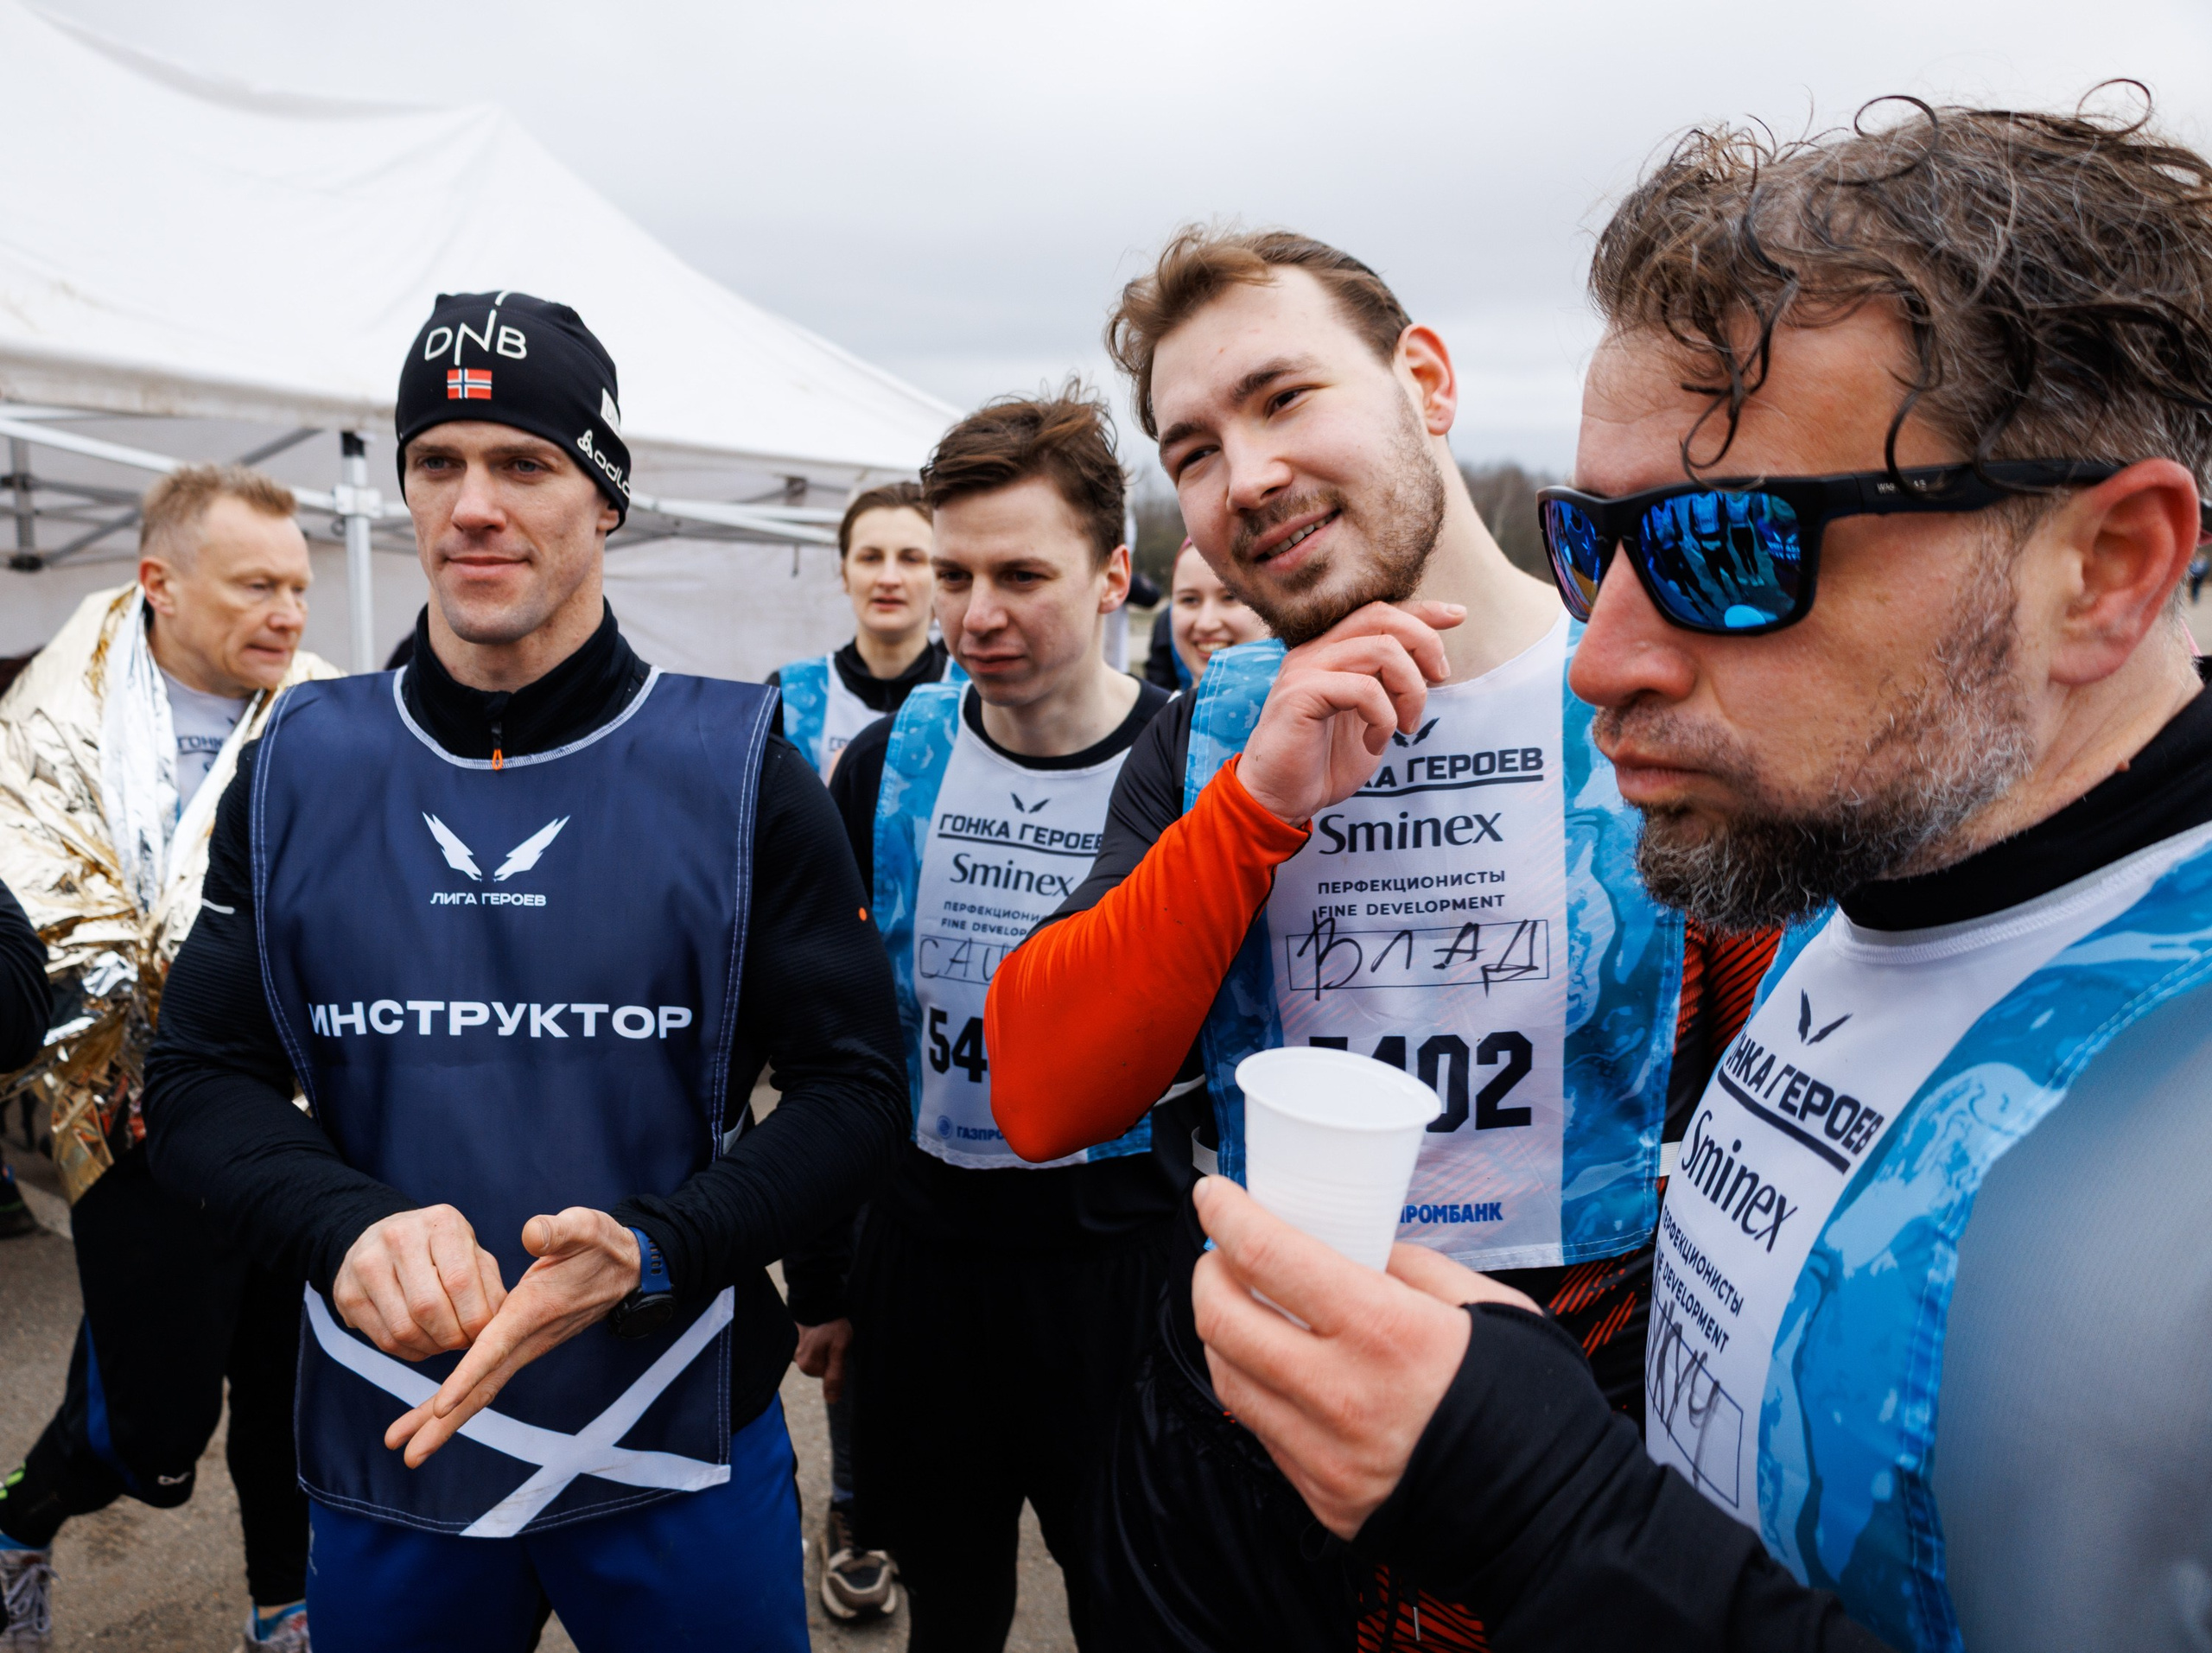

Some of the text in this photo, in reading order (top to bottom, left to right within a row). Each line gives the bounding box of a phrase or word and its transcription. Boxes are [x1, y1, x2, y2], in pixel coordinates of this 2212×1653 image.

[424, 308, 527, 366] DNB
[1407, 747, 1544, 783] ГЕРОЕВ
[939, 814, 1011, 839] ГОНКА
[1319, 811, 1504, 855] Sminex
[950, 853, 1074, 897] Sminex
[1318, 870, 1505, 893] ПЕРФЕКЦИОНИСТЫ
[430, 893, 546, 906] ЛИГА ГЕРОЕВ
[944, 901, 1044, 922] ПЕРФЕКЦИОНИ
[1319, 894, 1505, 919] FINE DEVELOPMENT
[941, 918, 967, 930] FINE
[1297, 910, 1539, 1001] ВЛАД
[308, 999, 692, 1039] ИНСТРУКТОР
[1763, 1063, 1885, 1156] ГЕРОЕВ
[1681, 1109, 1798, 1253] Sminex
[1662, 1261, 1729, 1354] DEVELOPMENT
